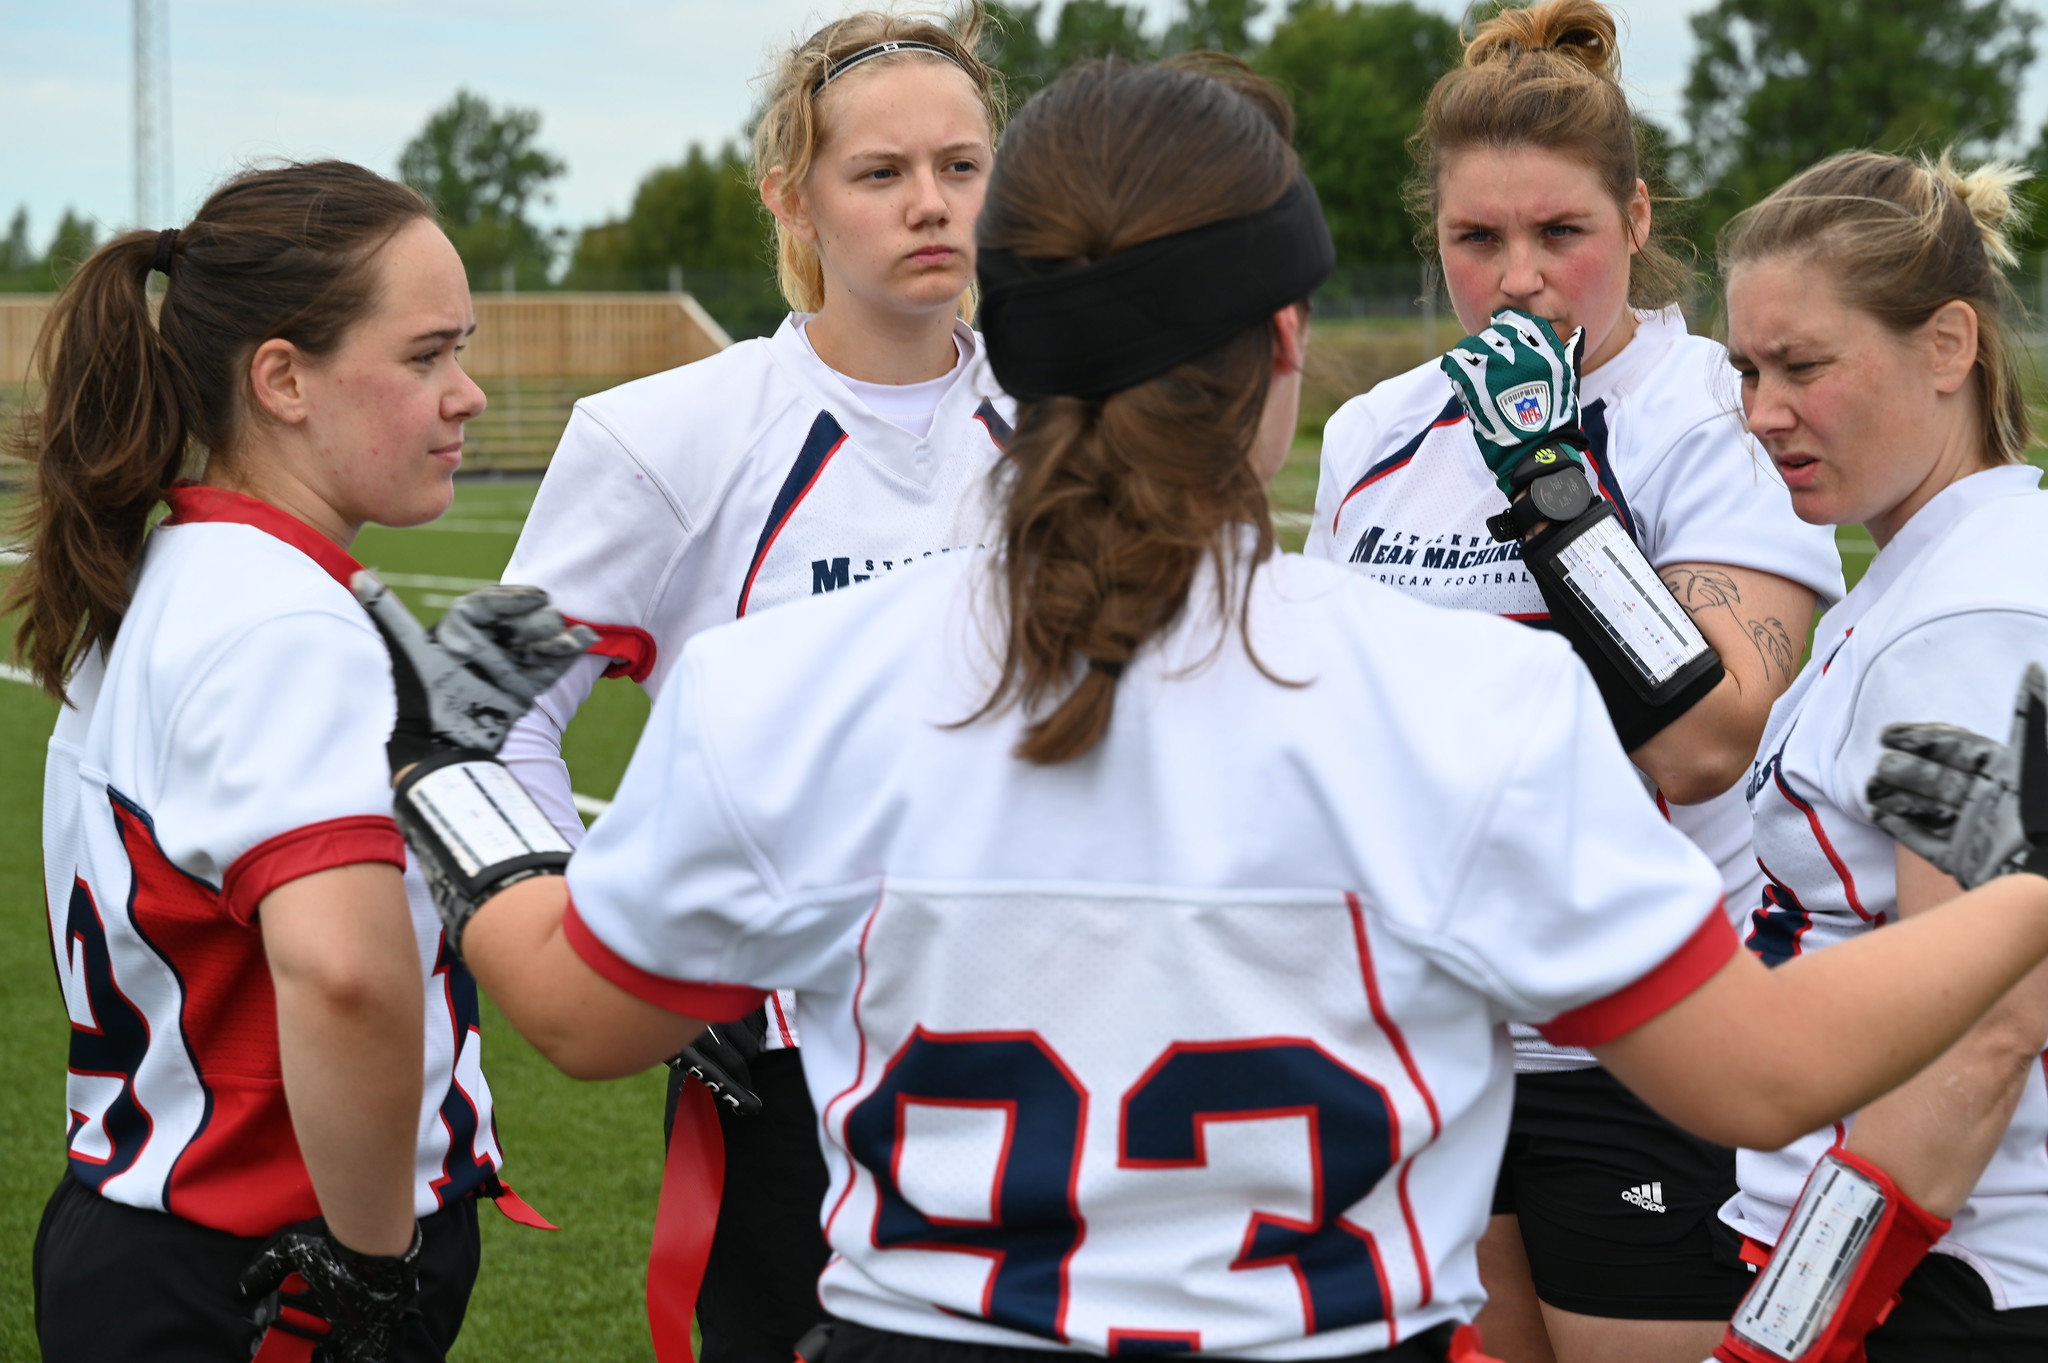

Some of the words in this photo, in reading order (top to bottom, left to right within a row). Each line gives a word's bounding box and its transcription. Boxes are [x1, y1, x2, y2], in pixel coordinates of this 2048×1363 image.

[1504, 387, 1544, 405] EQUIPMENT
[1520, 407, 1541, 424] NFL
[1349, 527, 1418, 565] MEAN
[1422, 542, 1523, 568] MACHINE
[1445, 573, 1530, 586] FOOTBAL
[844, 1023, 1400, 1352] 93
[1621, 1190, 1666, 1213] adidas
